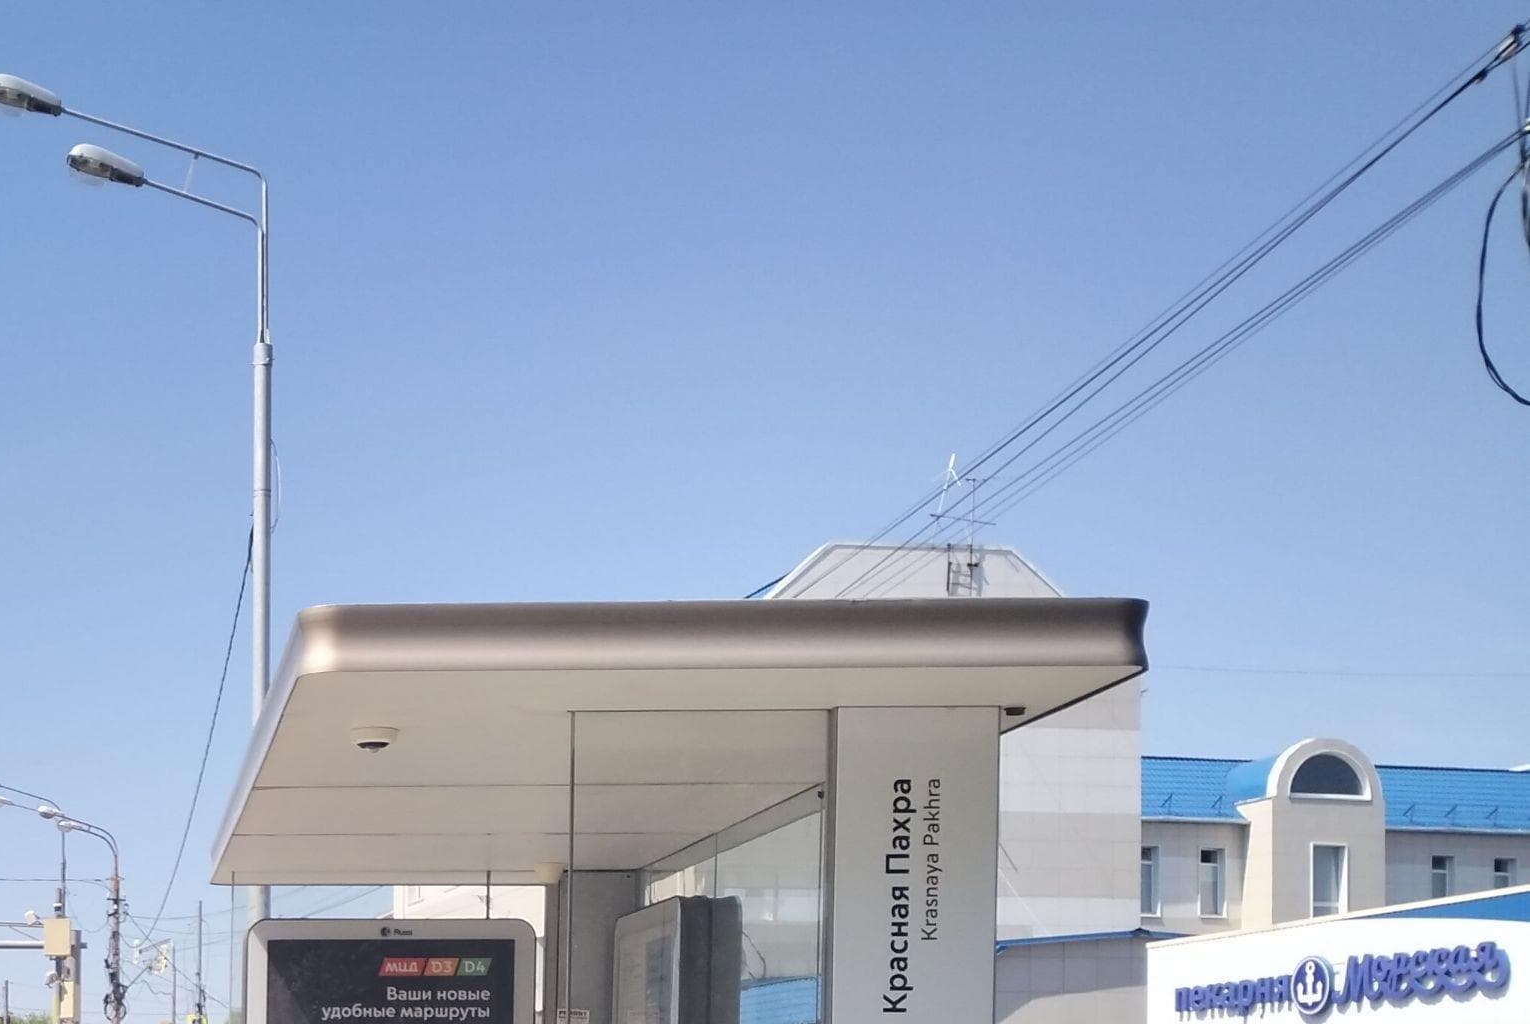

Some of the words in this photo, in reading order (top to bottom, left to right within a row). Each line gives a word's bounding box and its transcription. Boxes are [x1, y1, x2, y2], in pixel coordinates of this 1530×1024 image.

[885, 778, 917, 875] Пахра
[923, 778, 941, 846] Pakhra
[920, 852, 943, 941] Krasnaya
[464, 961, 486, 973] D4
[883, 885, 914, 1014] Красная
[1174, 974, 1294, 1017] пекарня
[1331, 941, 1511, 1005] Морская
[321, 1003, 396, 1021] удобные
[400, 1006, 490, 1021] маршруты
[386, 986, 432, 1001] Ваши
[437, 990, 491, 1001] новые
